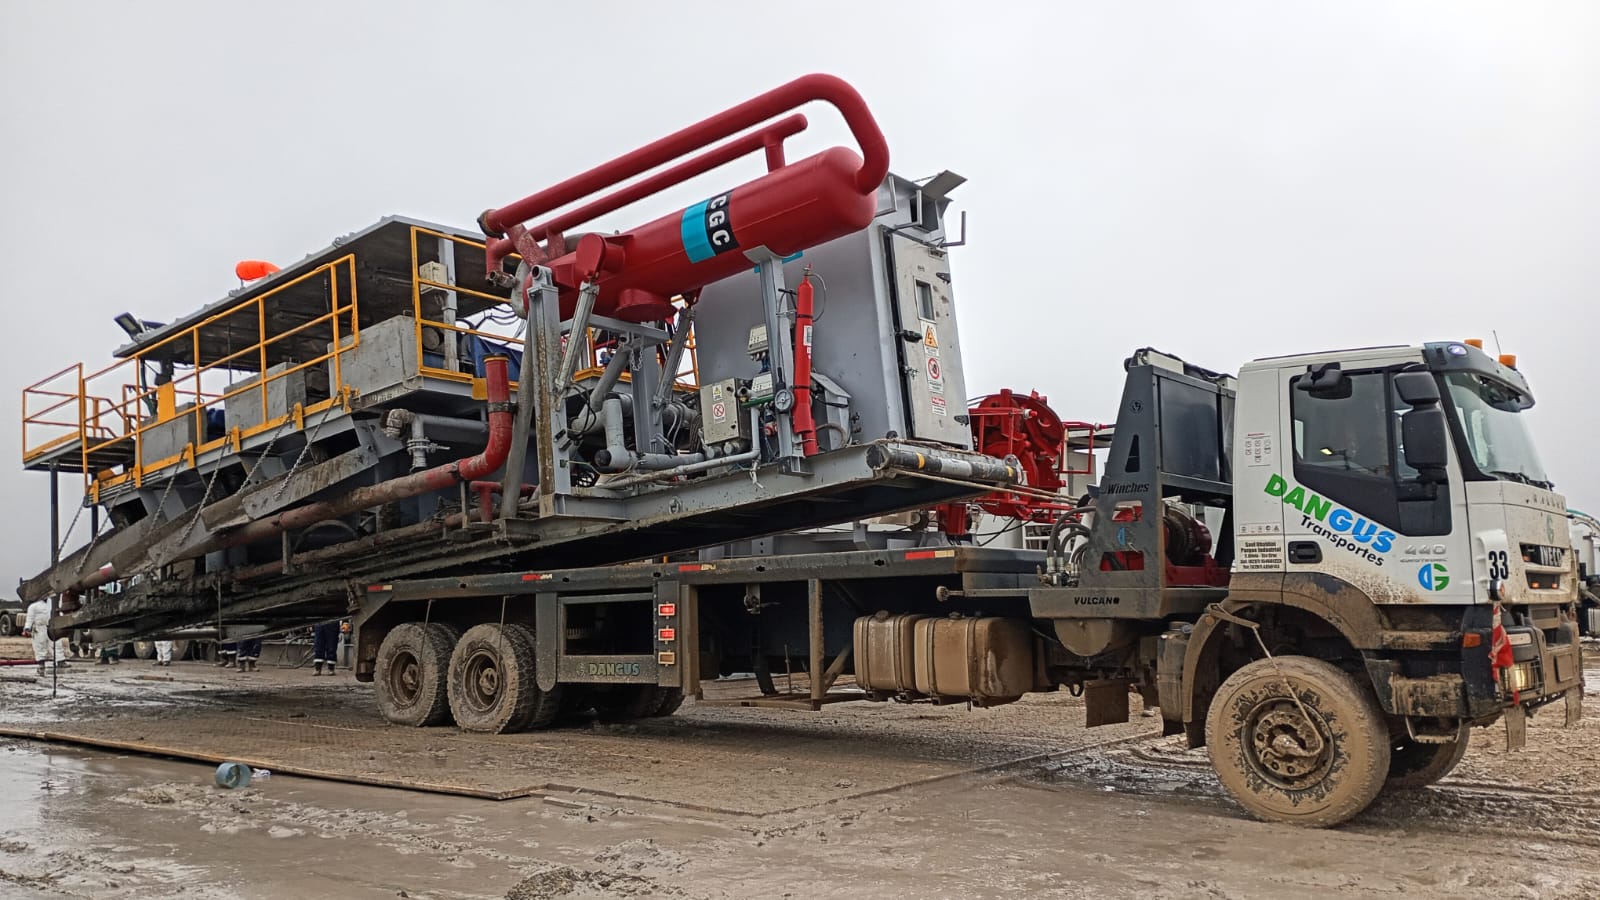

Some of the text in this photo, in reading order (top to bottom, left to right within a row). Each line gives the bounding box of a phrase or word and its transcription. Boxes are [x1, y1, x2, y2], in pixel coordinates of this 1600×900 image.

[708, 195, 731, 246] CGC
[1106, 482, 1150, 495] Winches
[1264, 473, 1396, 553] DANGUS
[1299, 514, 1385, 567] Transportes
[1404, 543, 1447, 556] 440
[1488, 550, 1509, 580] 33
[1540, 545, 1562, 567] IVECO
[589, 663, 641, 677] DANGUS
